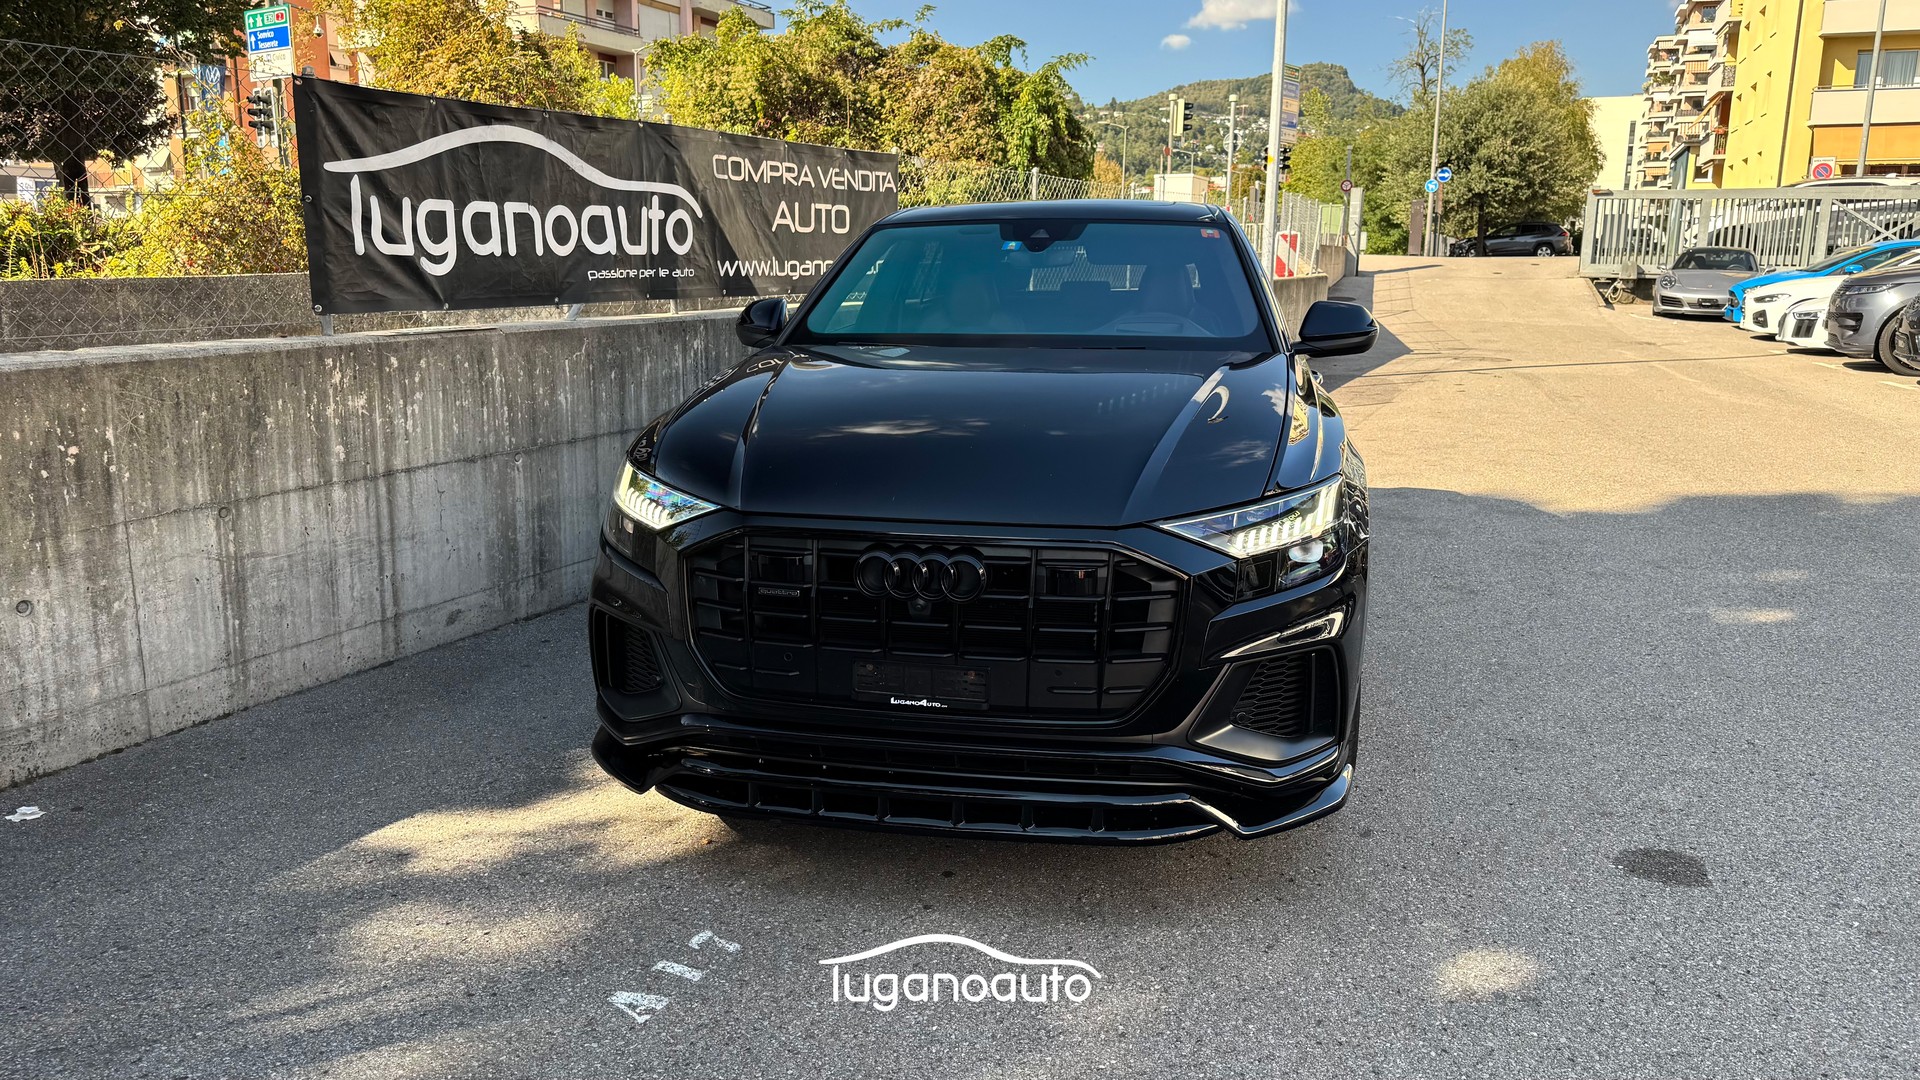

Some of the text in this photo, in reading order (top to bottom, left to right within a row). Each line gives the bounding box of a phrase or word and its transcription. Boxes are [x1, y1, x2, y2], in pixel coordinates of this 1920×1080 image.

[257, 31, 274, 39] Sonvico
[258, 40, 278, 48] Tesserete
[712, 154, 897, 194] COMPRA VENDITA
[350, 174, 694, 276] luganoauto
[771, 200, 850, 234] AUTO
[587, 267, 695, 281] passione per le auto
